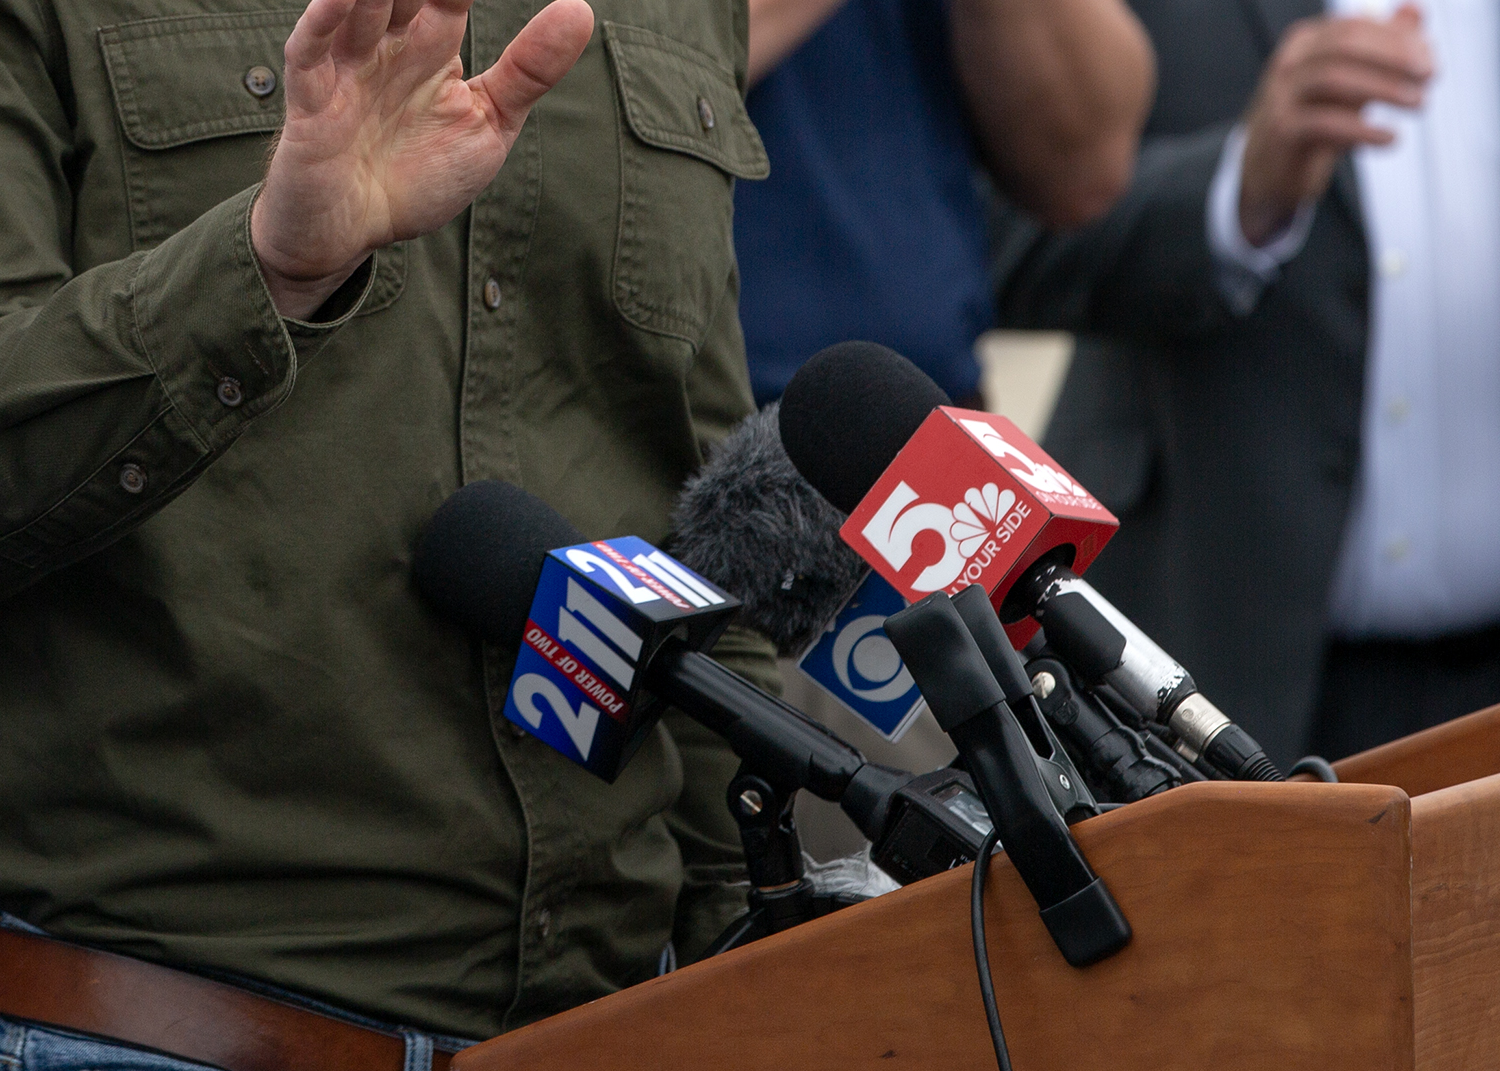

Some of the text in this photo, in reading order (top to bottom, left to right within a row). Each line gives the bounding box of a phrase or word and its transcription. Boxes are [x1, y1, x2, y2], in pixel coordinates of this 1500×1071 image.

[959, 418, 1055, 494] 5
[565, 548, 662, 604] 2
[861, 480, 968, 592] 5
[957, 499, 1032, 586] YOUR SIDE
[512, 672, 600, 762] 2
[558, 576, 644, 692] 11
[526, 628, 625, 715] POWER OF TWO
